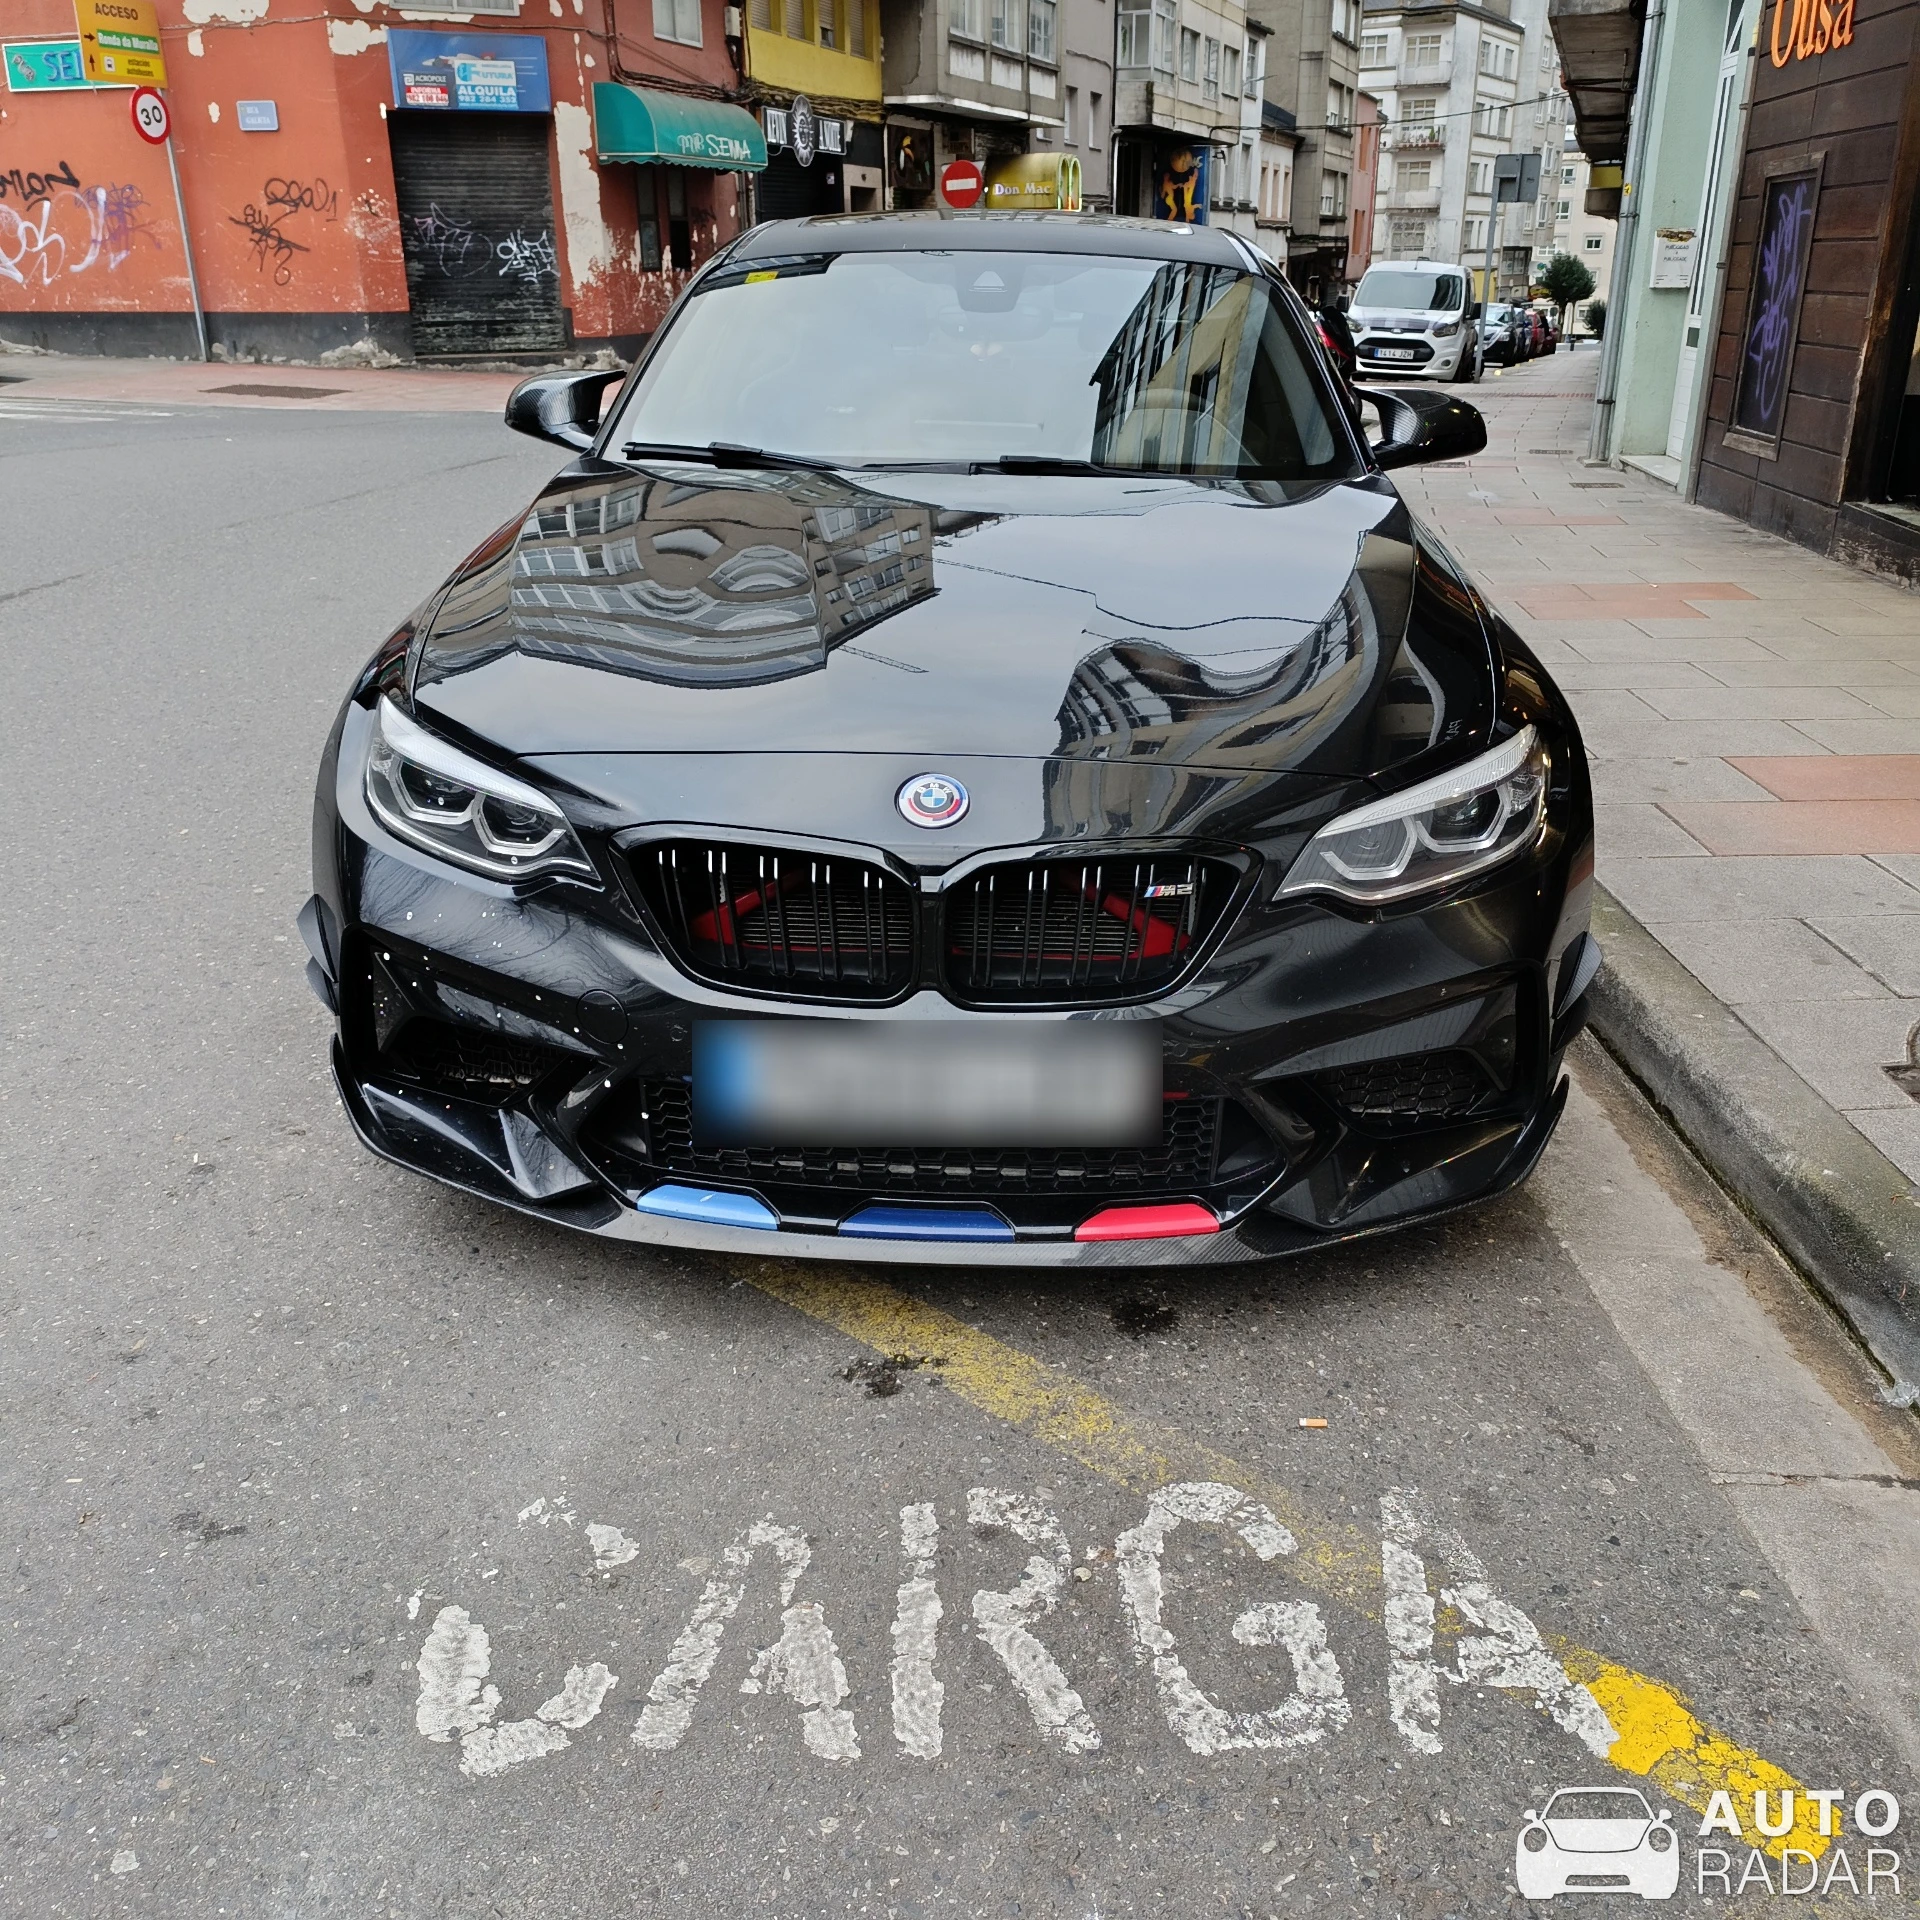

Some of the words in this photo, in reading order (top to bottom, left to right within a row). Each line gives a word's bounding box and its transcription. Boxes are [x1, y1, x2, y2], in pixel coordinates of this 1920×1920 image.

[95, 2, 139, 21] ACCESO
[458, 86, 516, 96] ALQUILA
[140, 105, 163, 126] 30
[993, 183, 1020, 195] Don
[1024, 182, 1051, 194] Mac
[916, 782, 953, 794] BMW
[1157, 883, 1194, 897] M2
